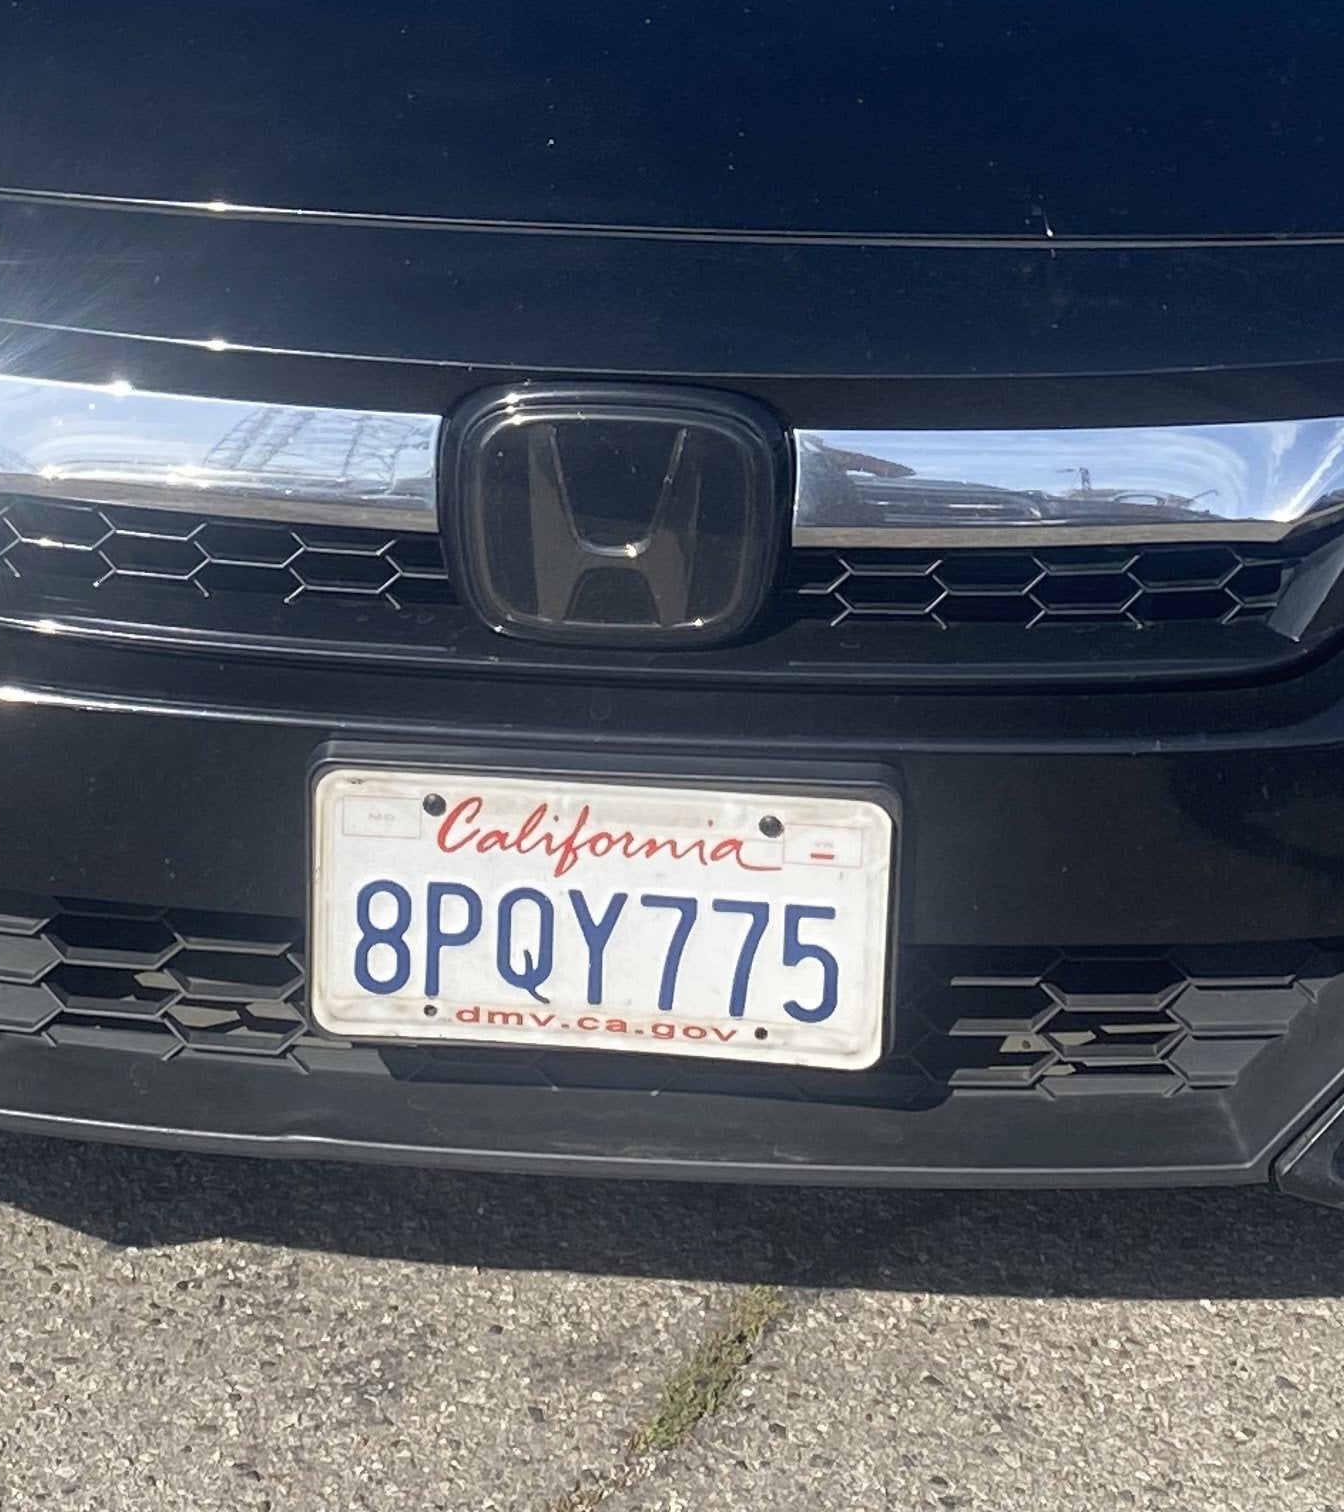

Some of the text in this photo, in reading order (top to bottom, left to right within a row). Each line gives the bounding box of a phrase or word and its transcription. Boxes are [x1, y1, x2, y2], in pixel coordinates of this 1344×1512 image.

[437, 795, 783, 878] California
[353, 879, 840, 1024] 8PQY775
[455, 1005, 739, 1043] dmv.ca.gov
